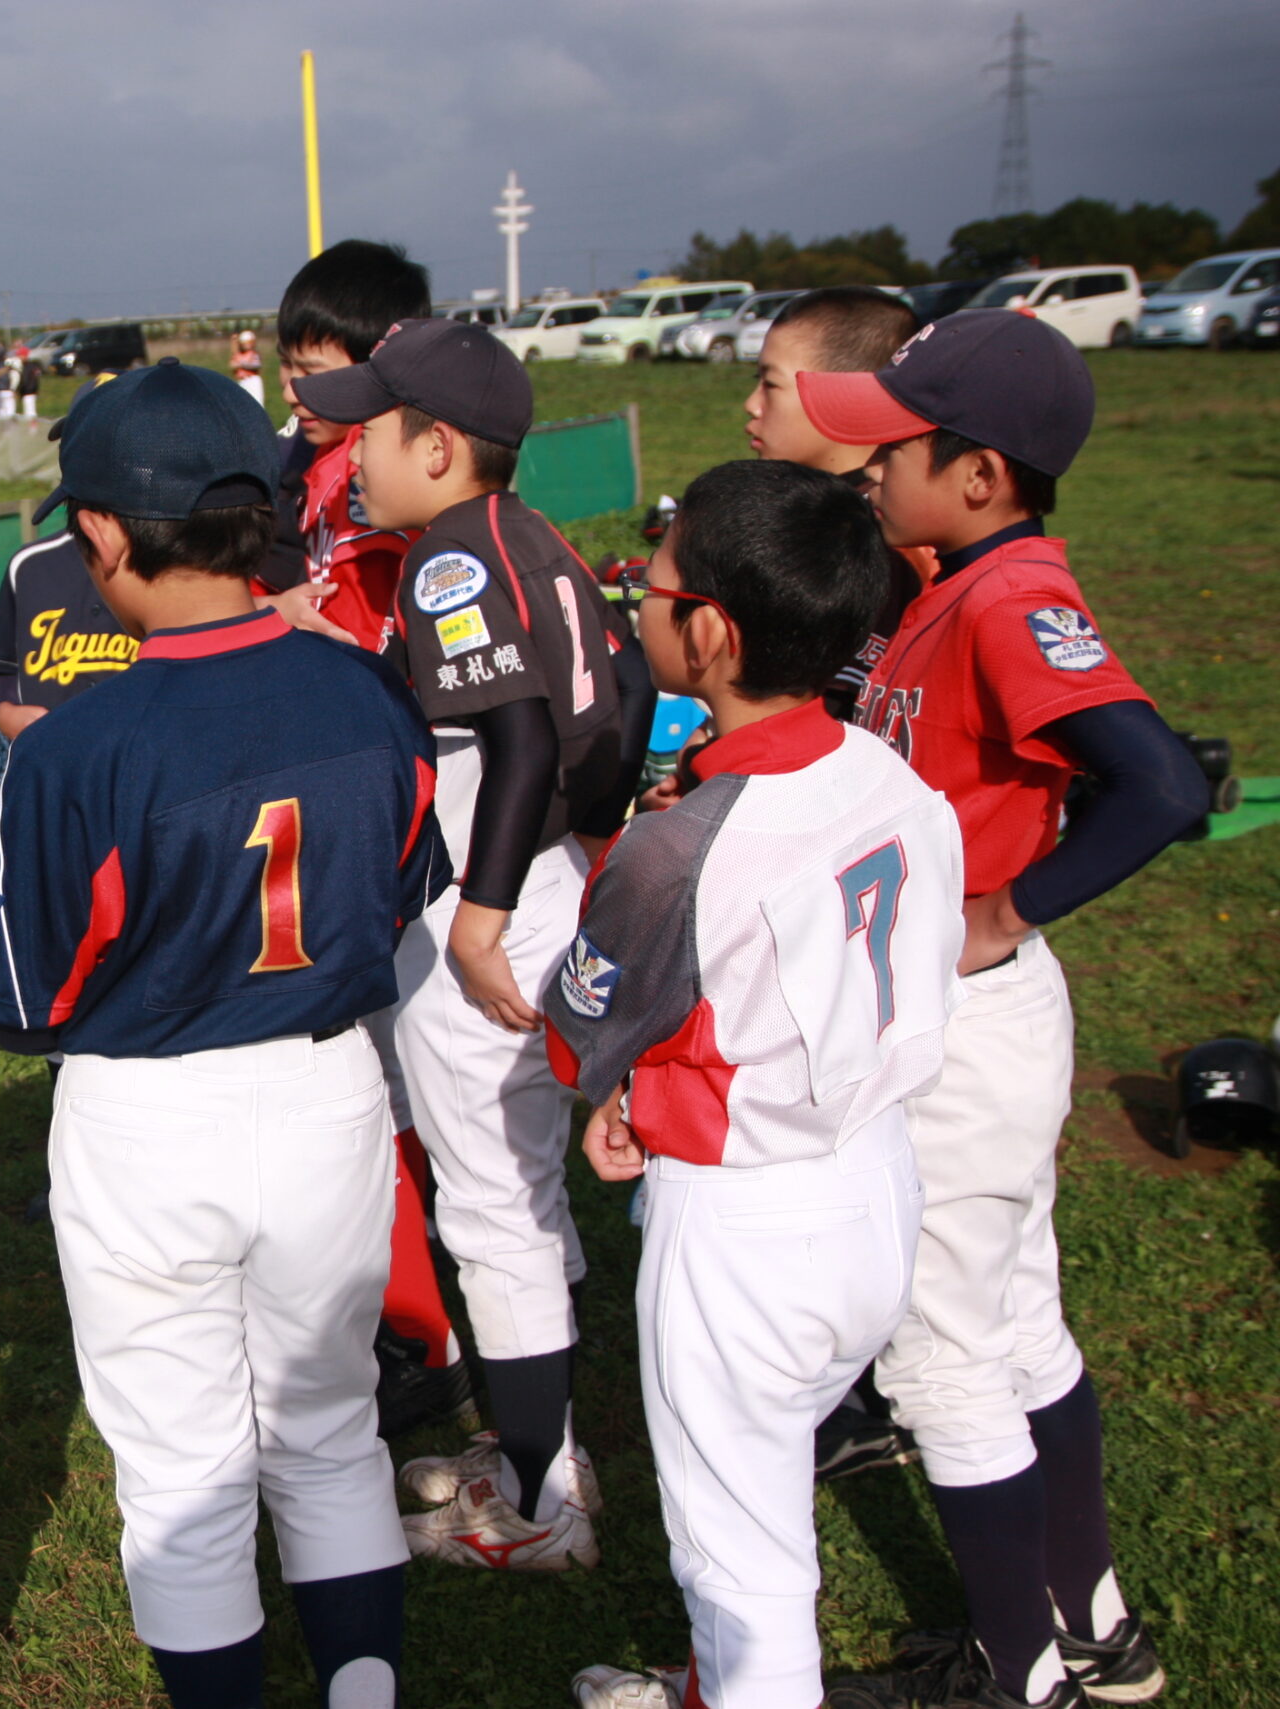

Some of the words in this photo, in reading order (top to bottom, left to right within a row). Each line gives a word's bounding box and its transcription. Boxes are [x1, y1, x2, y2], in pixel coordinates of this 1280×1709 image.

[436, 643, 525, 691] 東札幌
[244, 797, 314, 975] 1
[835, 836, 910, 1042] 7
